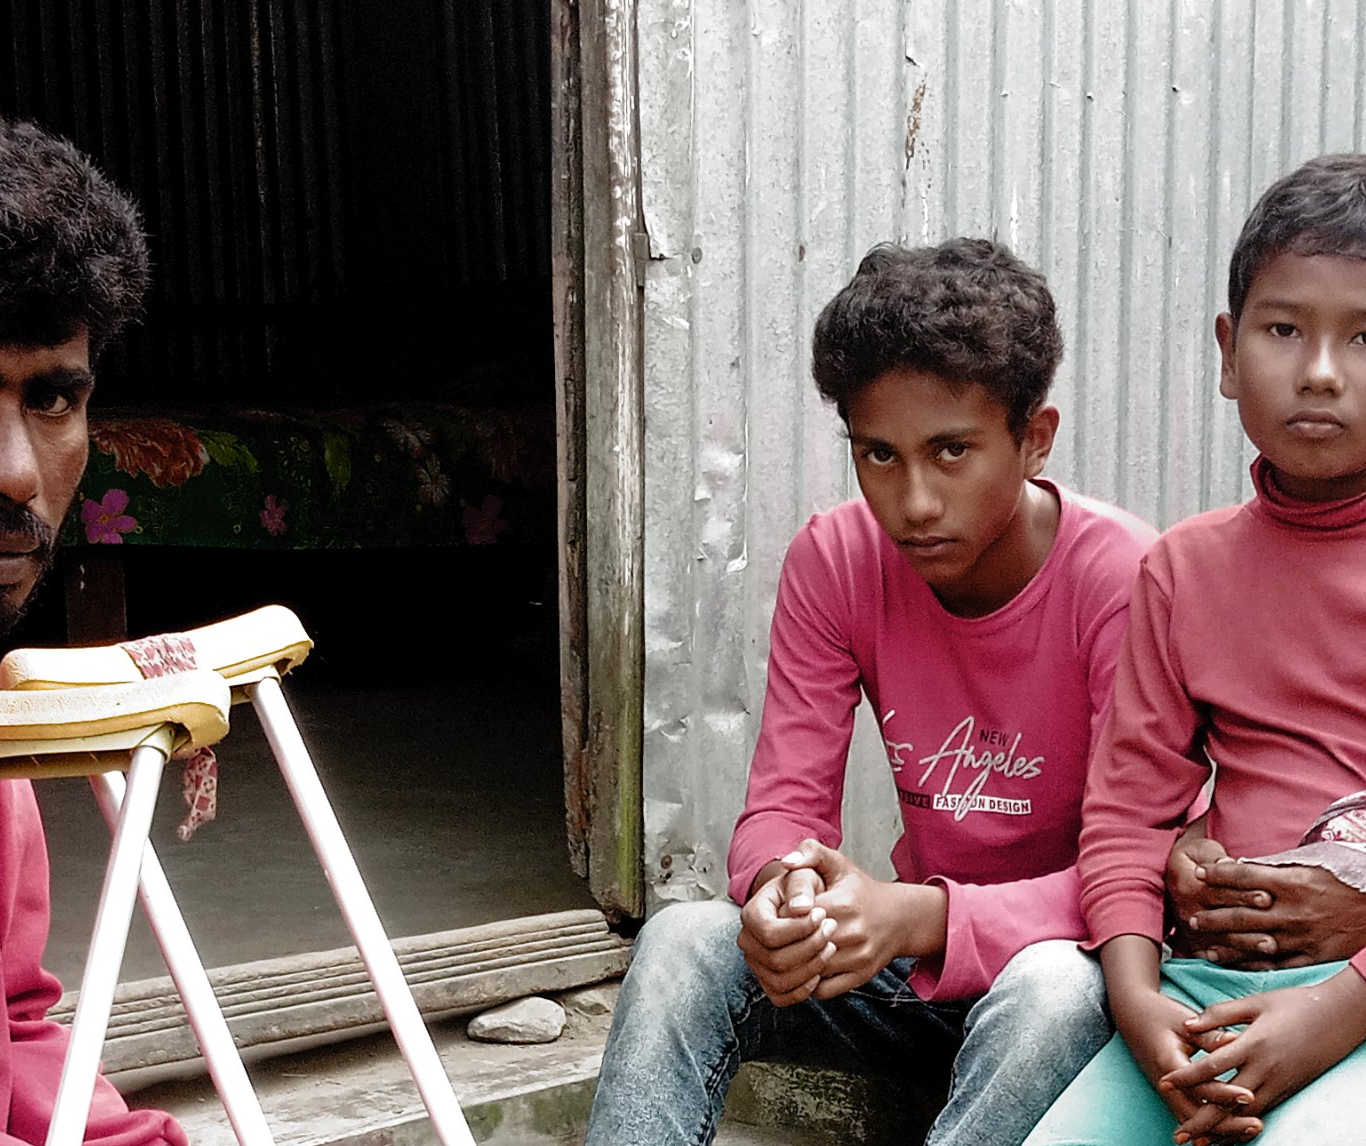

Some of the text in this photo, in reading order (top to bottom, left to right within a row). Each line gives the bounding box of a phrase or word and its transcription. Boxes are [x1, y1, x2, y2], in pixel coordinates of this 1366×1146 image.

[979, 729, 1009, 747] NEW
[918, 715, 1046, 821] Angeles
[935, 796, 985, 809] FASON
[988, 799, 1030, 813] DESIGN
